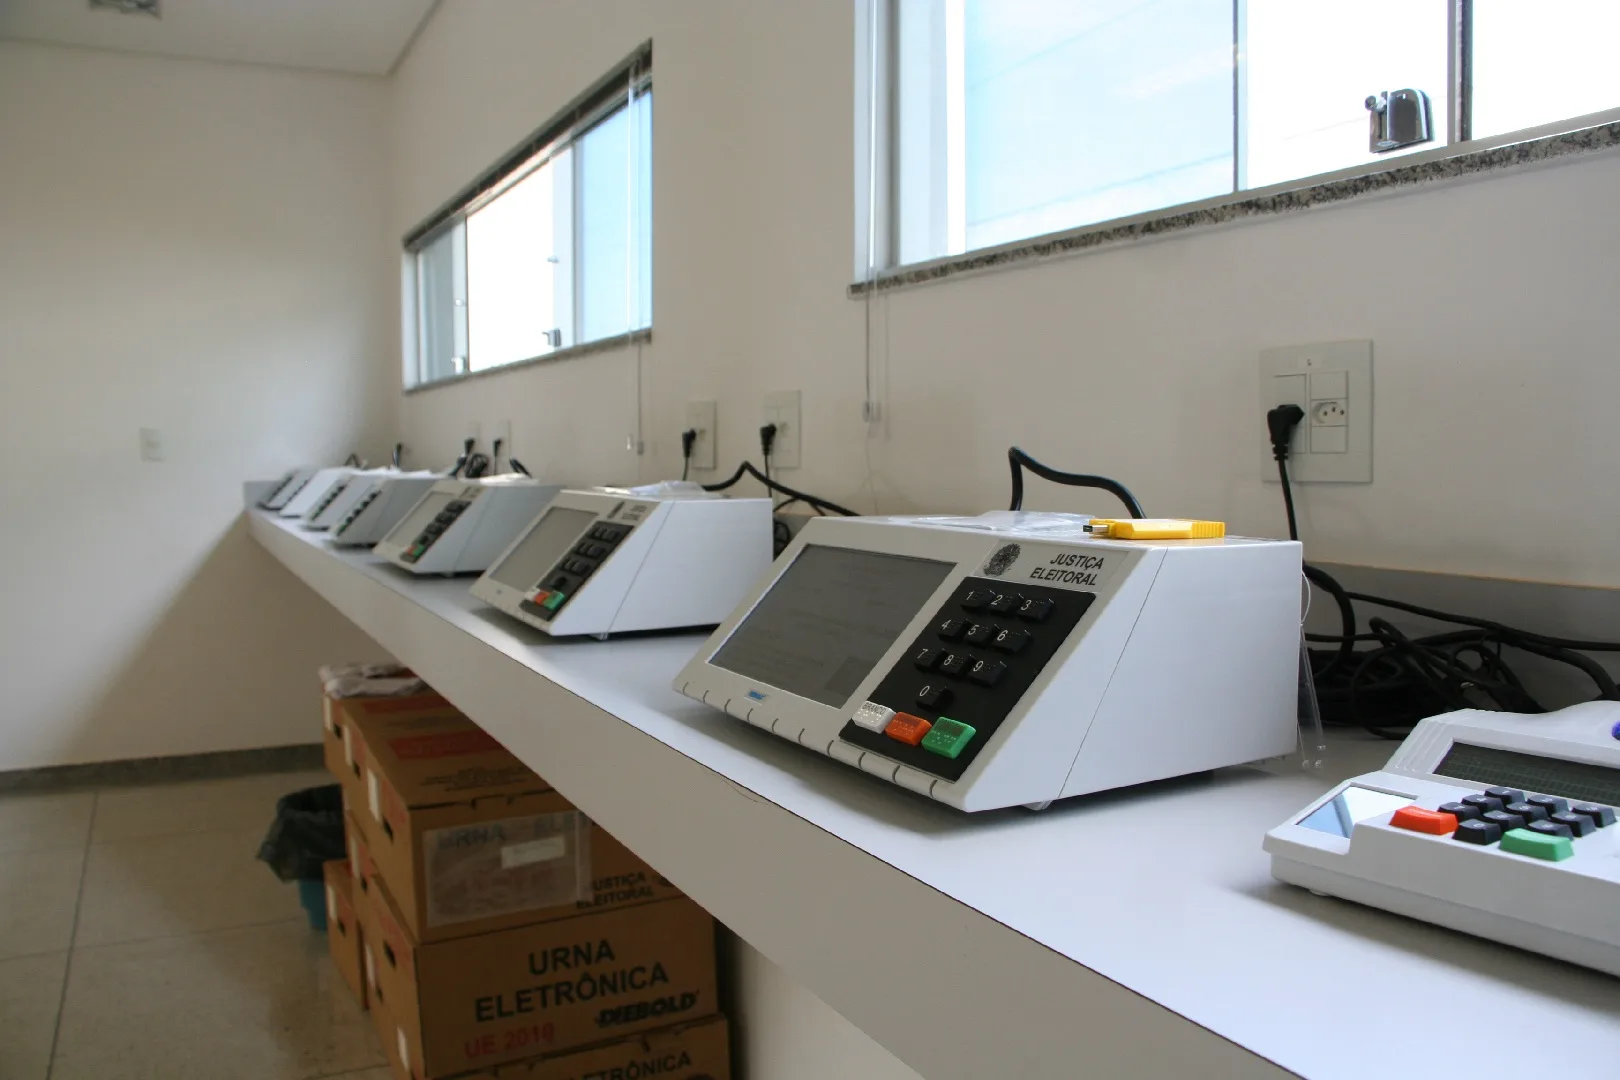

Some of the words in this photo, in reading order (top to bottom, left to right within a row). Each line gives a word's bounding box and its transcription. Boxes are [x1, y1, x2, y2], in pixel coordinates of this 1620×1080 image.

[1050, 553, 1104, 570] JUSTIÇA
[1030, 567, 1097, 585] ELEITORAL
[966, 591, 974, 600] 1
[991, 595, 1003, 606] 2
[1021, 599, 1032, 611] 3
[941, 619, 951, 630] 4
[968, 624, 979, 635] 5
[997, 630, 1008, 641] 6
[917, 648, 928, 659] 7
[944, 655, 954, 665] 8
[973, 660, 984, 672] 9
[919, 685, 930, 697] 0
[588, 871, 646, 891] USTIÇA
[528, 939, 616, 976] URNA
[474, 961, 669, 1023] ELETRÔNICA
[597, 991, 697, 1028] DIEBOLD
[464, 1034, 497, 1058] UE
[504, 1022, 555, 1050] 2010
